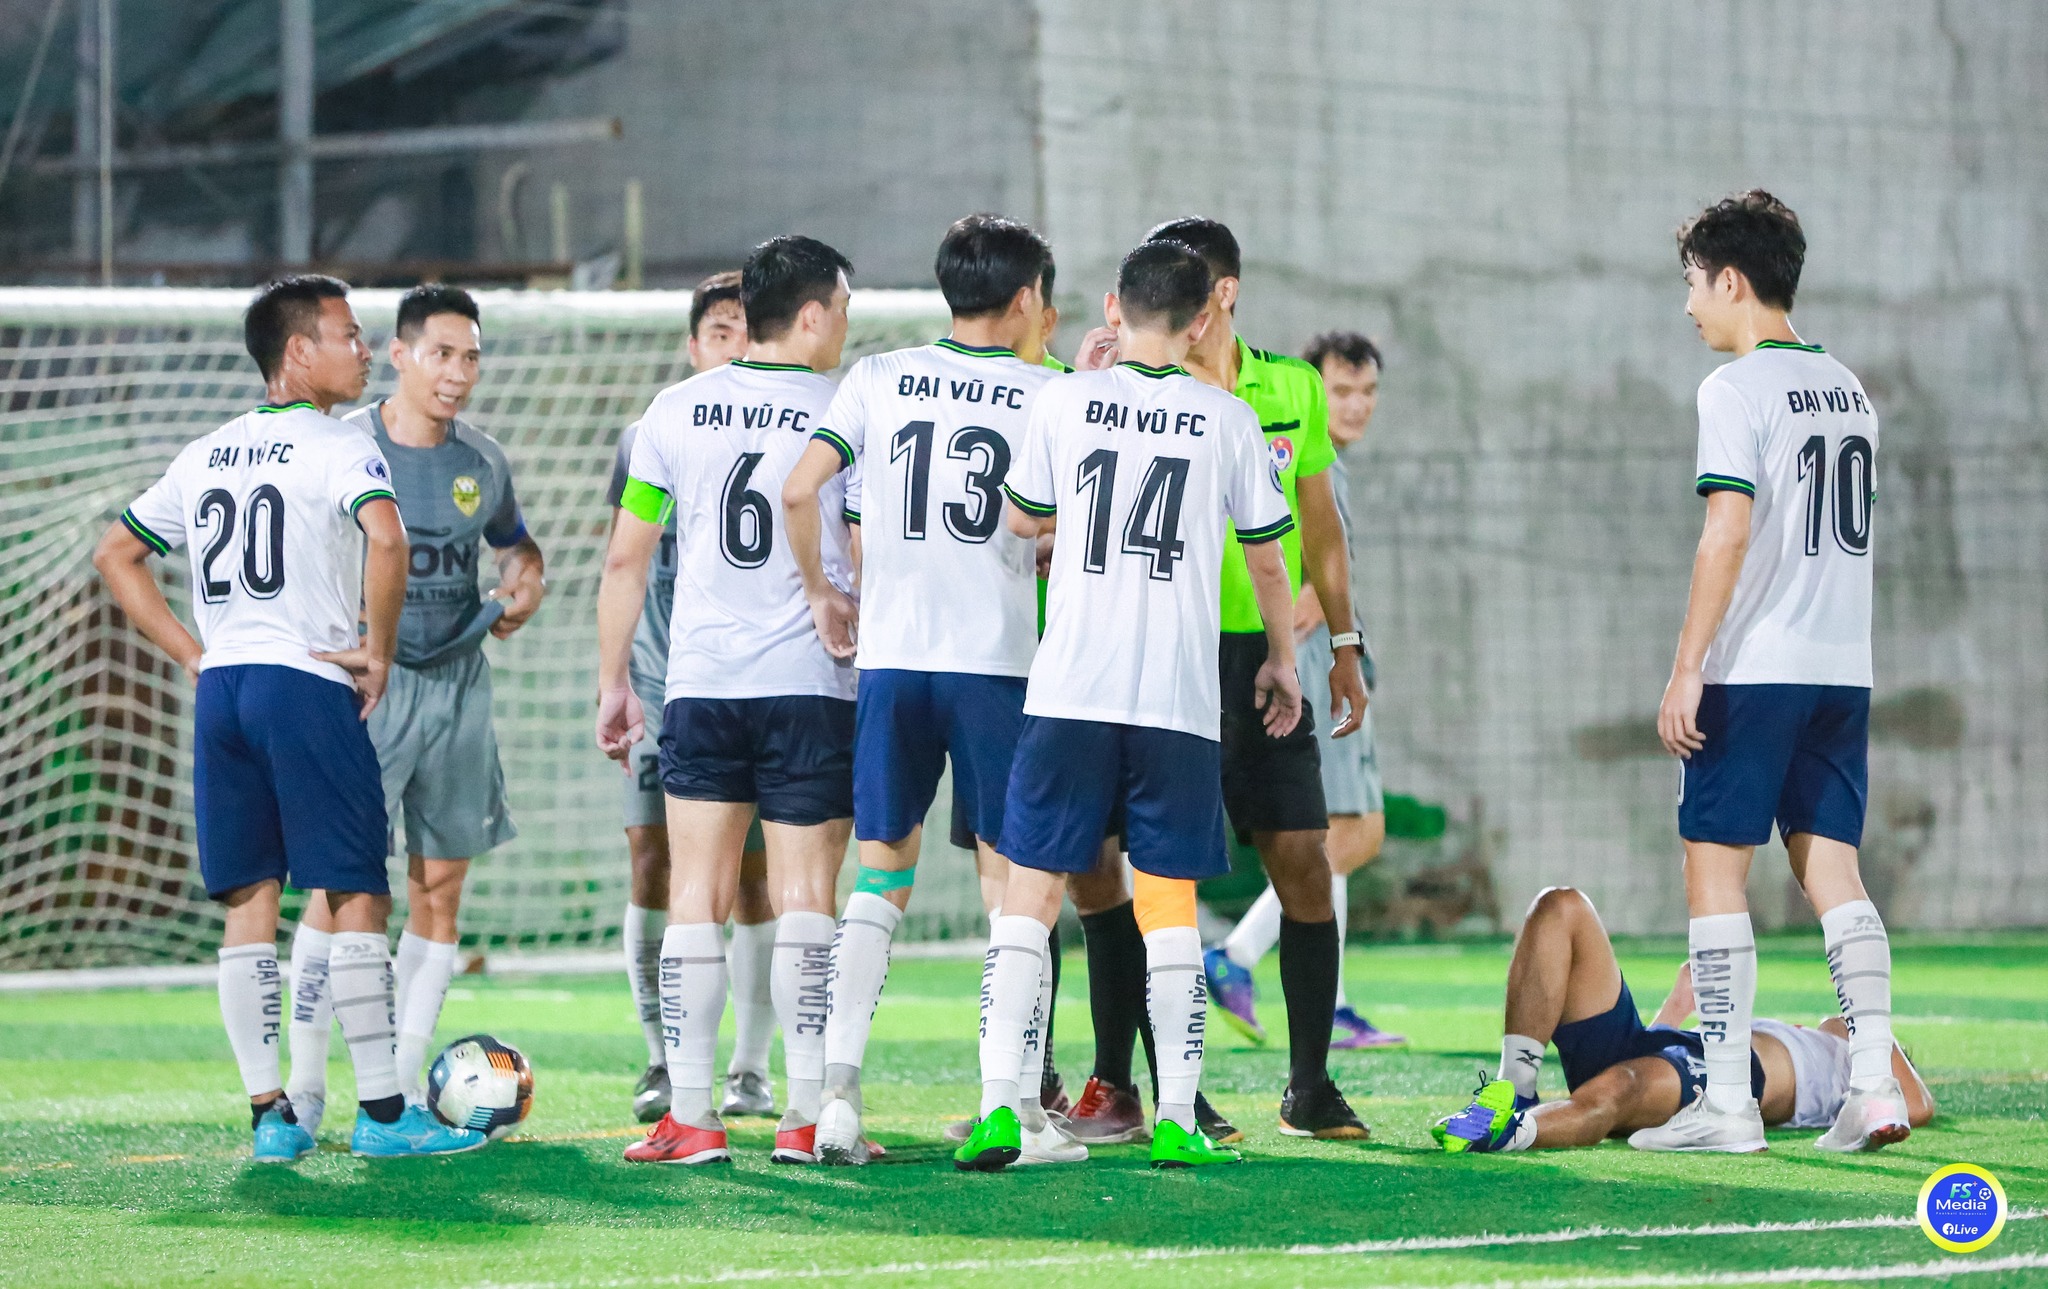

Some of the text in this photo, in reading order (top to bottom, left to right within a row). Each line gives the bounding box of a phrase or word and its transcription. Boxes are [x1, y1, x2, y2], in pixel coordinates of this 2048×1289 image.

[899, 374, 1025, 410] ĐẠI VŨ FC
[1786, 387, 1870, 417] ĐẠI VŨ FC
[692, 403, 811, 433] ĐẠI VŨ FC
[1085, 400, 1207, 437] ĐẠI VŨ FC
[208, 446, 240, 472] ĐẠI
[267, 443, 294, 464] FC
[890, 420, 1012, 544] 13
[1797, 435, 1873, 556] 10
[718, 452, 773, 570] 6
[1076, 448, 1191, 582] 14
[194, 483, 285, 605] 20
[1692, 948, 1735, 1043] ĐẠI VŨ FC
[263, 1022, 280, 1045] FC
[662, 1025, 681, 1048] FC
[796, 1012, 827, 1036] FC
[1183, 1039, 1203, 1060] FC
